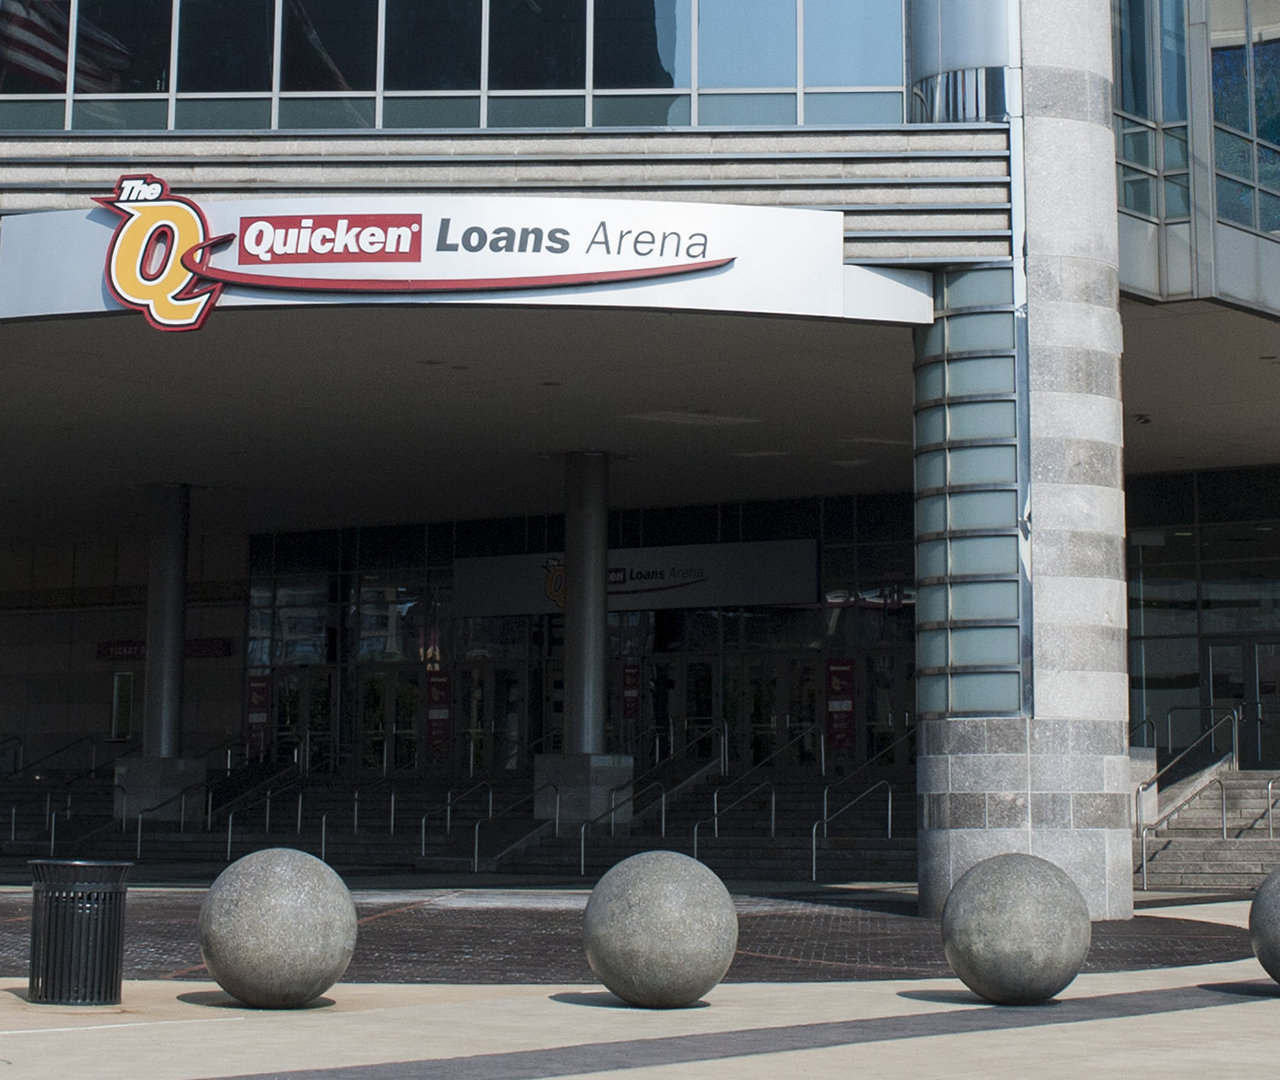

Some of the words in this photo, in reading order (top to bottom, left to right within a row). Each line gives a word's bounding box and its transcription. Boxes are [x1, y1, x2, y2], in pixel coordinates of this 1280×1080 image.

[120, 179, 162, 201] The
[435, 218, 570, 254] Loans
[586, 221, 709, 259] Arena
[111, 200, 211, 325] Q
